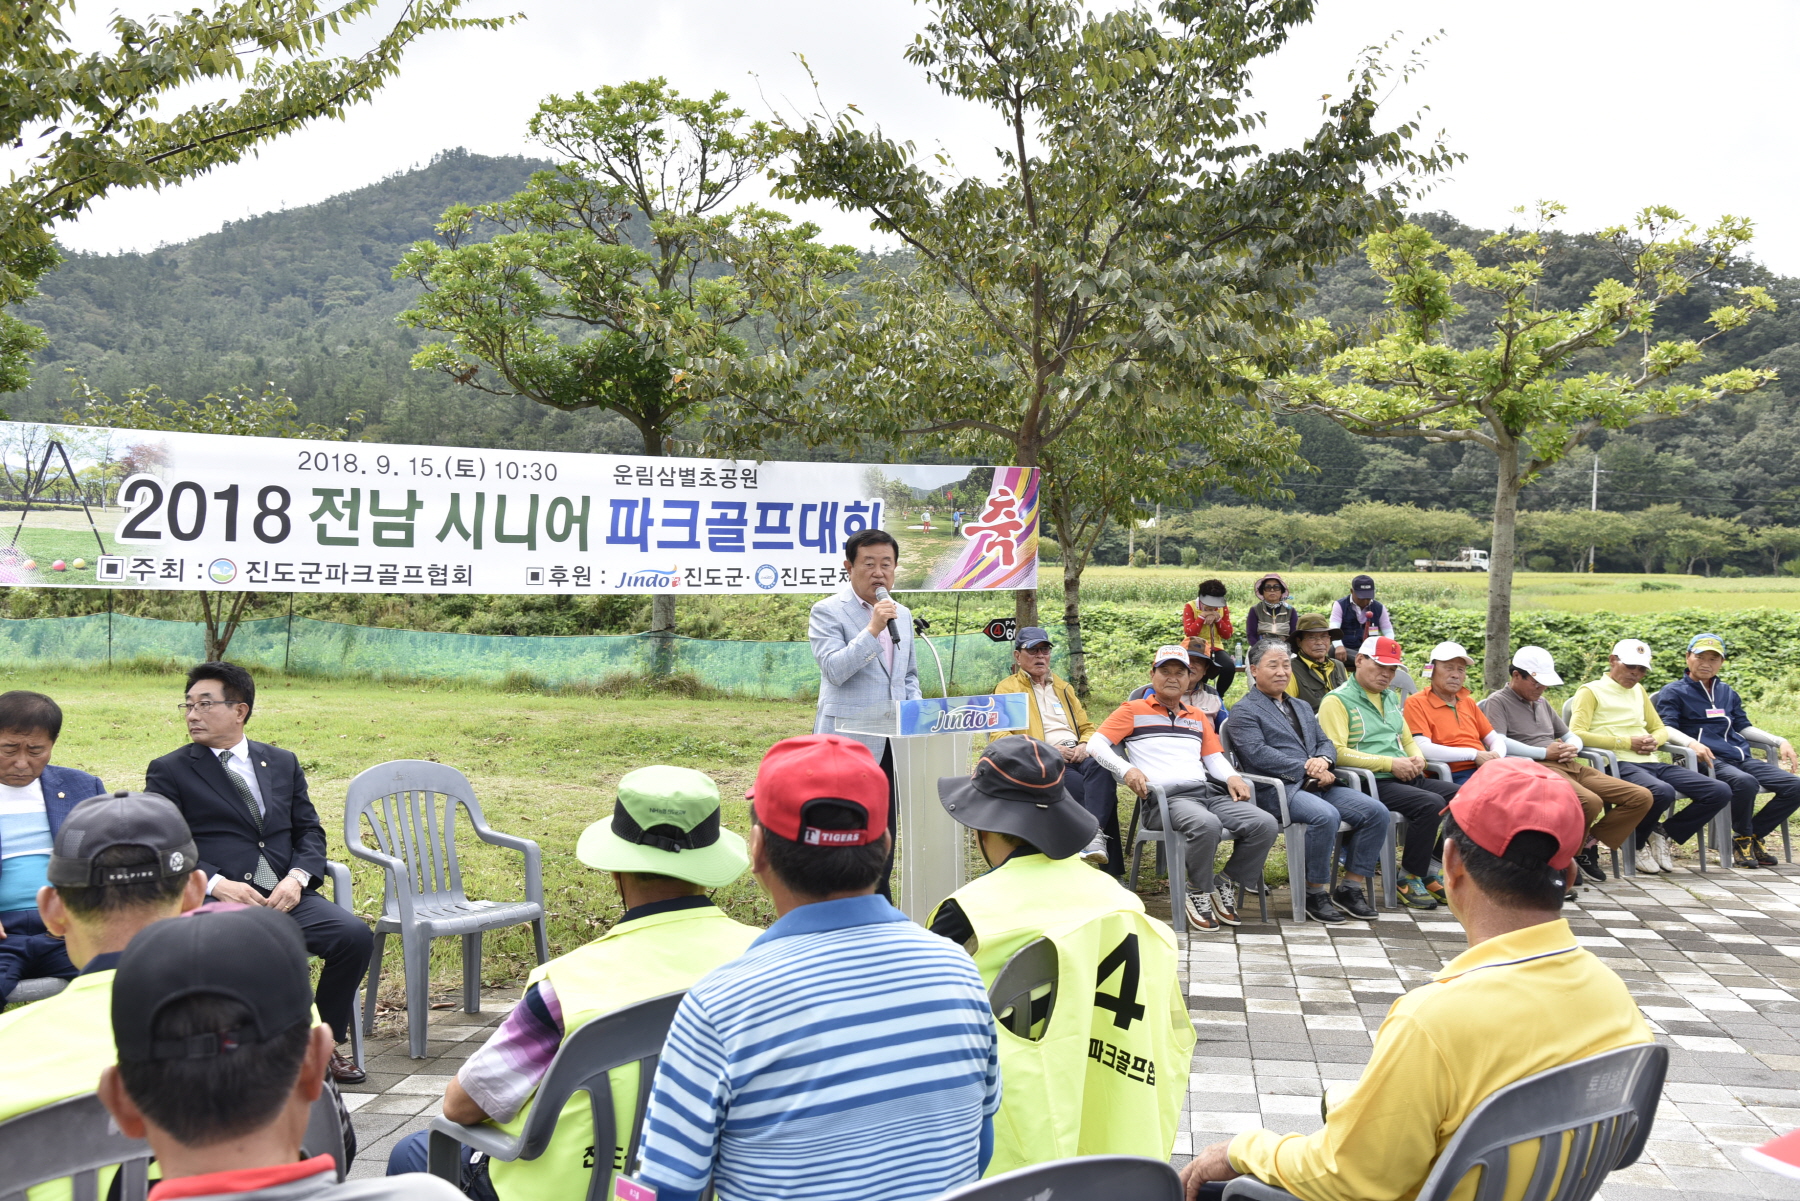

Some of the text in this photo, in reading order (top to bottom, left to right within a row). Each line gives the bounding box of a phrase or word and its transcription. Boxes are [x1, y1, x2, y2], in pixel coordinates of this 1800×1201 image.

[298, 450, 366, 475] 2018.
[376, 455, 399, 476] 9.
[495, 461, 558, 482] 10:30
[613, 464, 758, 489] 운림삼별초공원
[121, 479, 881, 555] 2018 전남 시니어 파크골프대회
[964, 488, 1023, 566] 축
[129, 557, 185, 583] 주최
[245, 560, 472, 587] 진도군파크골프협회
[548, 565, 592, 588] 후원
[993, 623, 1003, 636] 4
[930, 710, 987, 733] Jindo
[821, 832, 860, 842] TIGERS
[1094, 932, 1145, 1031] 4
